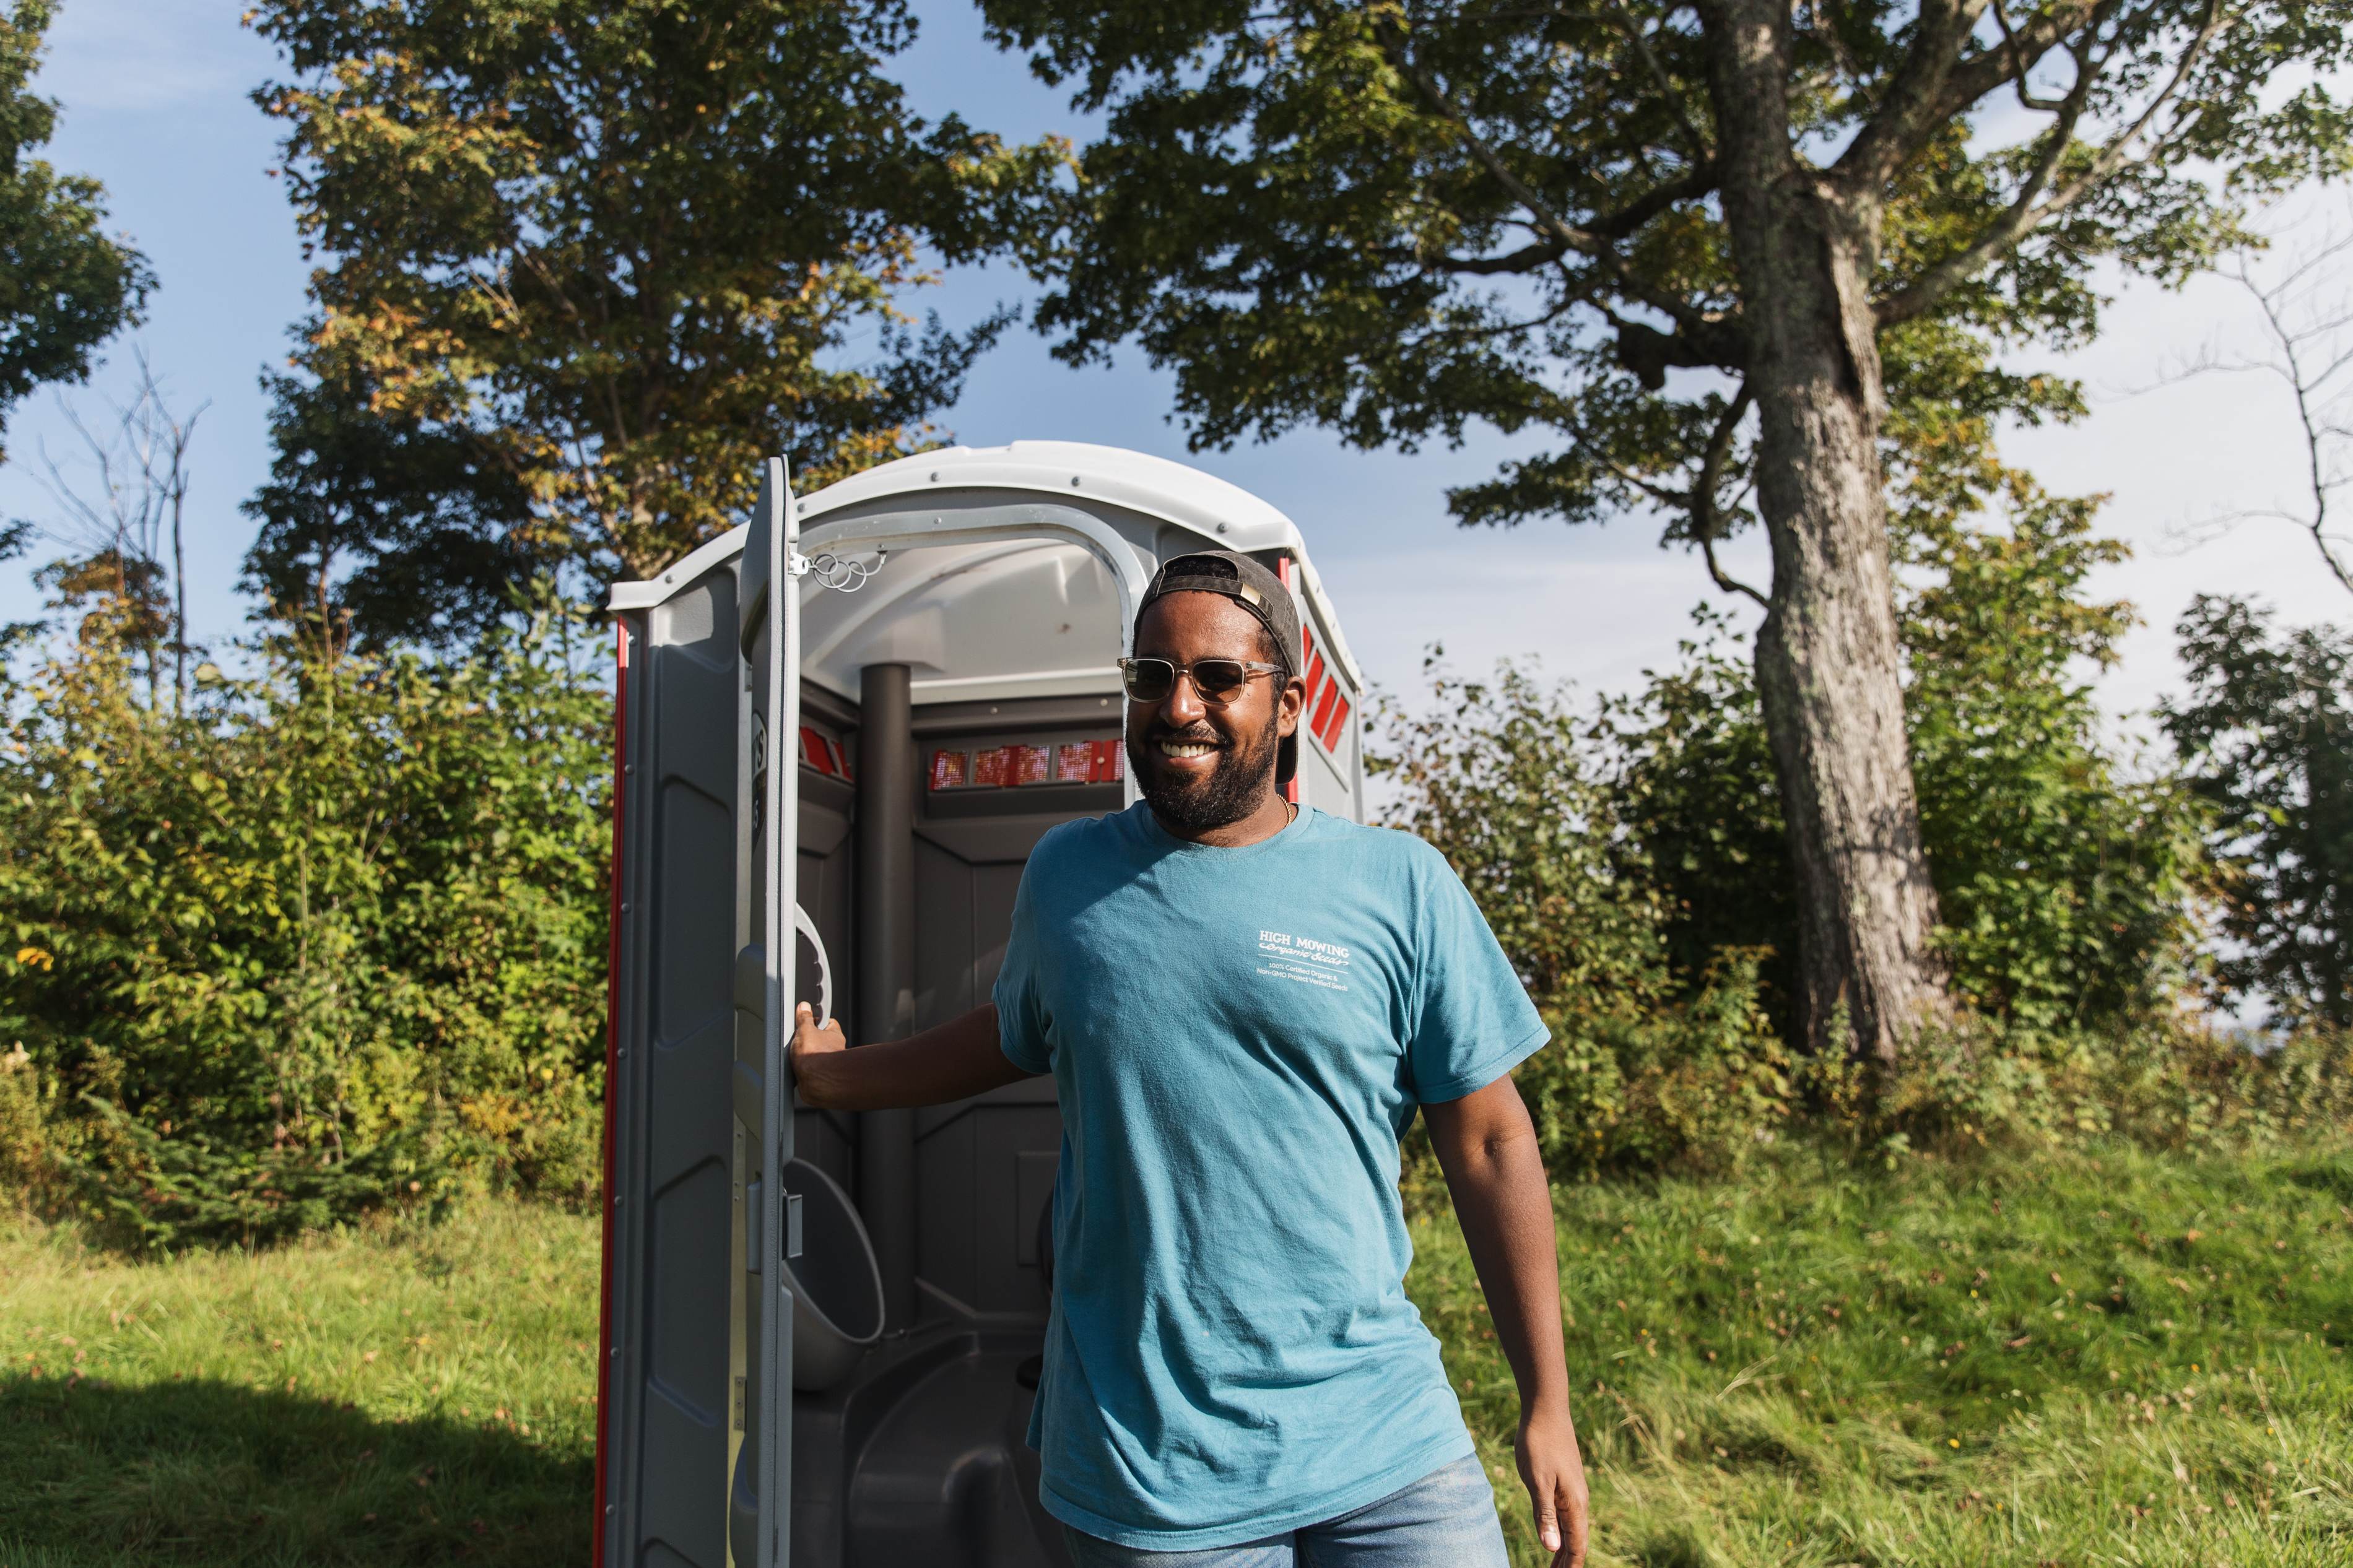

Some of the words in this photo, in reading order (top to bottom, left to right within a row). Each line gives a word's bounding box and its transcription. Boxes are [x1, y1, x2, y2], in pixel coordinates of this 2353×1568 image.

[1259, 930, 1291, 945] HIGH
[1296, 937, 1350, 958] MOWING
[1259, 943, 1311, 957] Organic
[1311, 952, 1349, 966] Seeds
[1257, 968, 1287, 978] Non-GMO
[1287, 972, 1308, 983] Project
[1309, 977, 1331, 987] Verified
[1285, 964, 1310, 976] Certified
[1310, 970, 1333, 981] Organic
